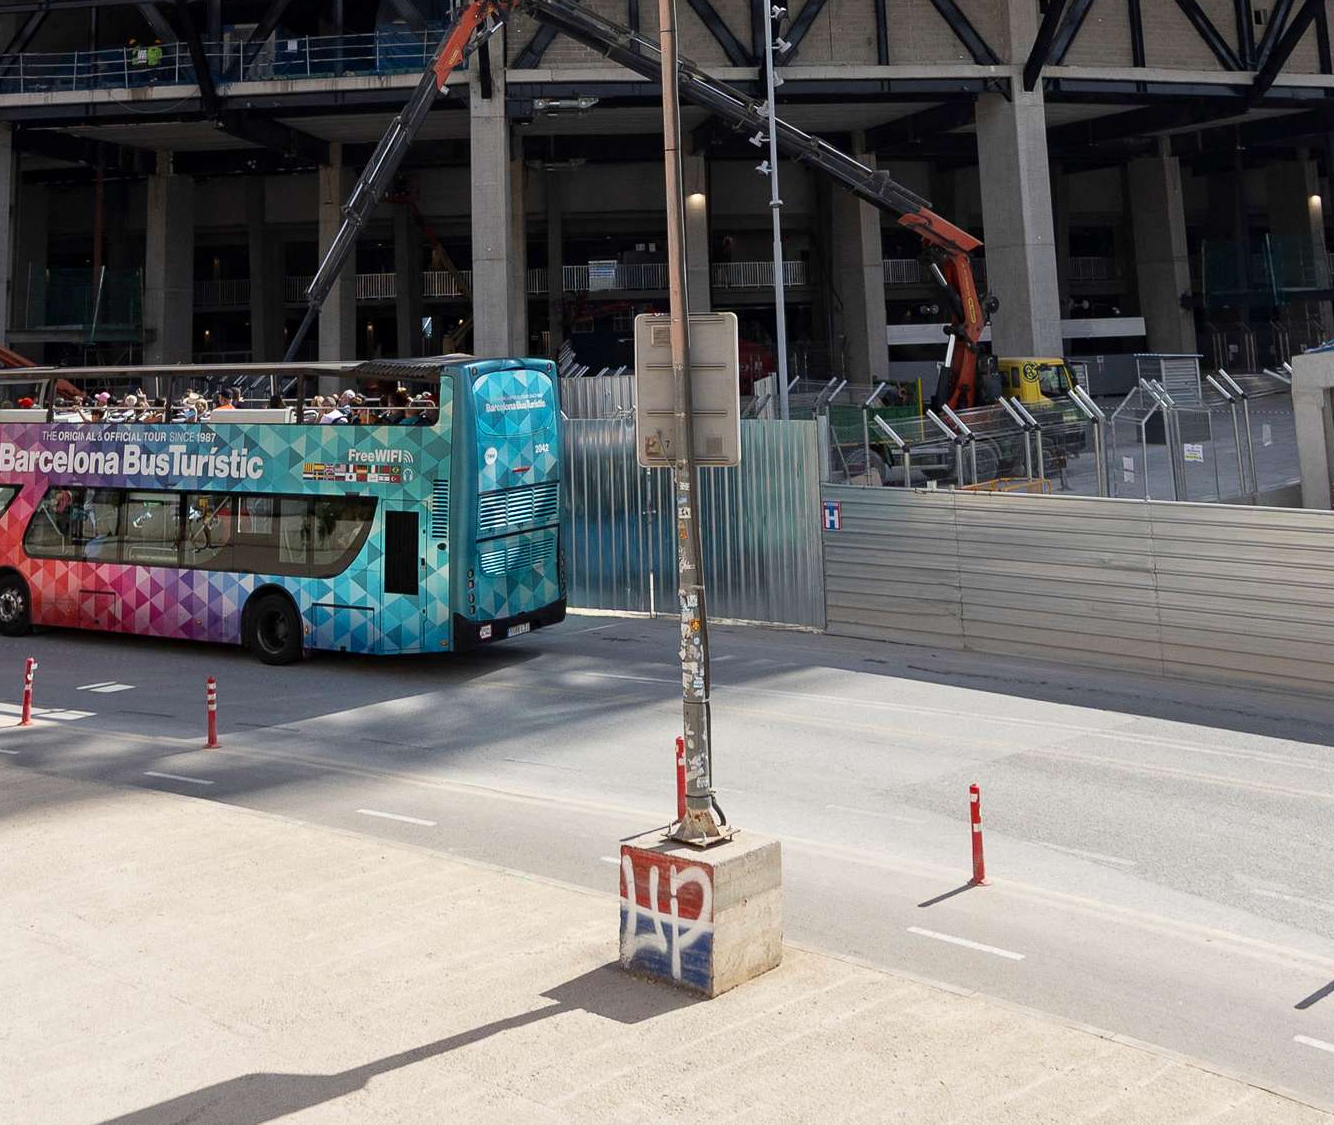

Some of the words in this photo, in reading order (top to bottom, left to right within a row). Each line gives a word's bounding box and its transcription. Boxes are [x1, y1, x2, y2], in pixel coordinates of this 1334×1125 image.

[42, 430, 58, 441] THE
[58, 431, 97, 442] ORIGINAL
[97, 431, 103, 442] &
[104, 431, 142, 442] OFFICIAL
[144, 432, 167, 442] TOUR
[169, 432, 195, 442] SINCE
[197, 432, 217, 443] 1987
[824, 508, 840, 529] H
